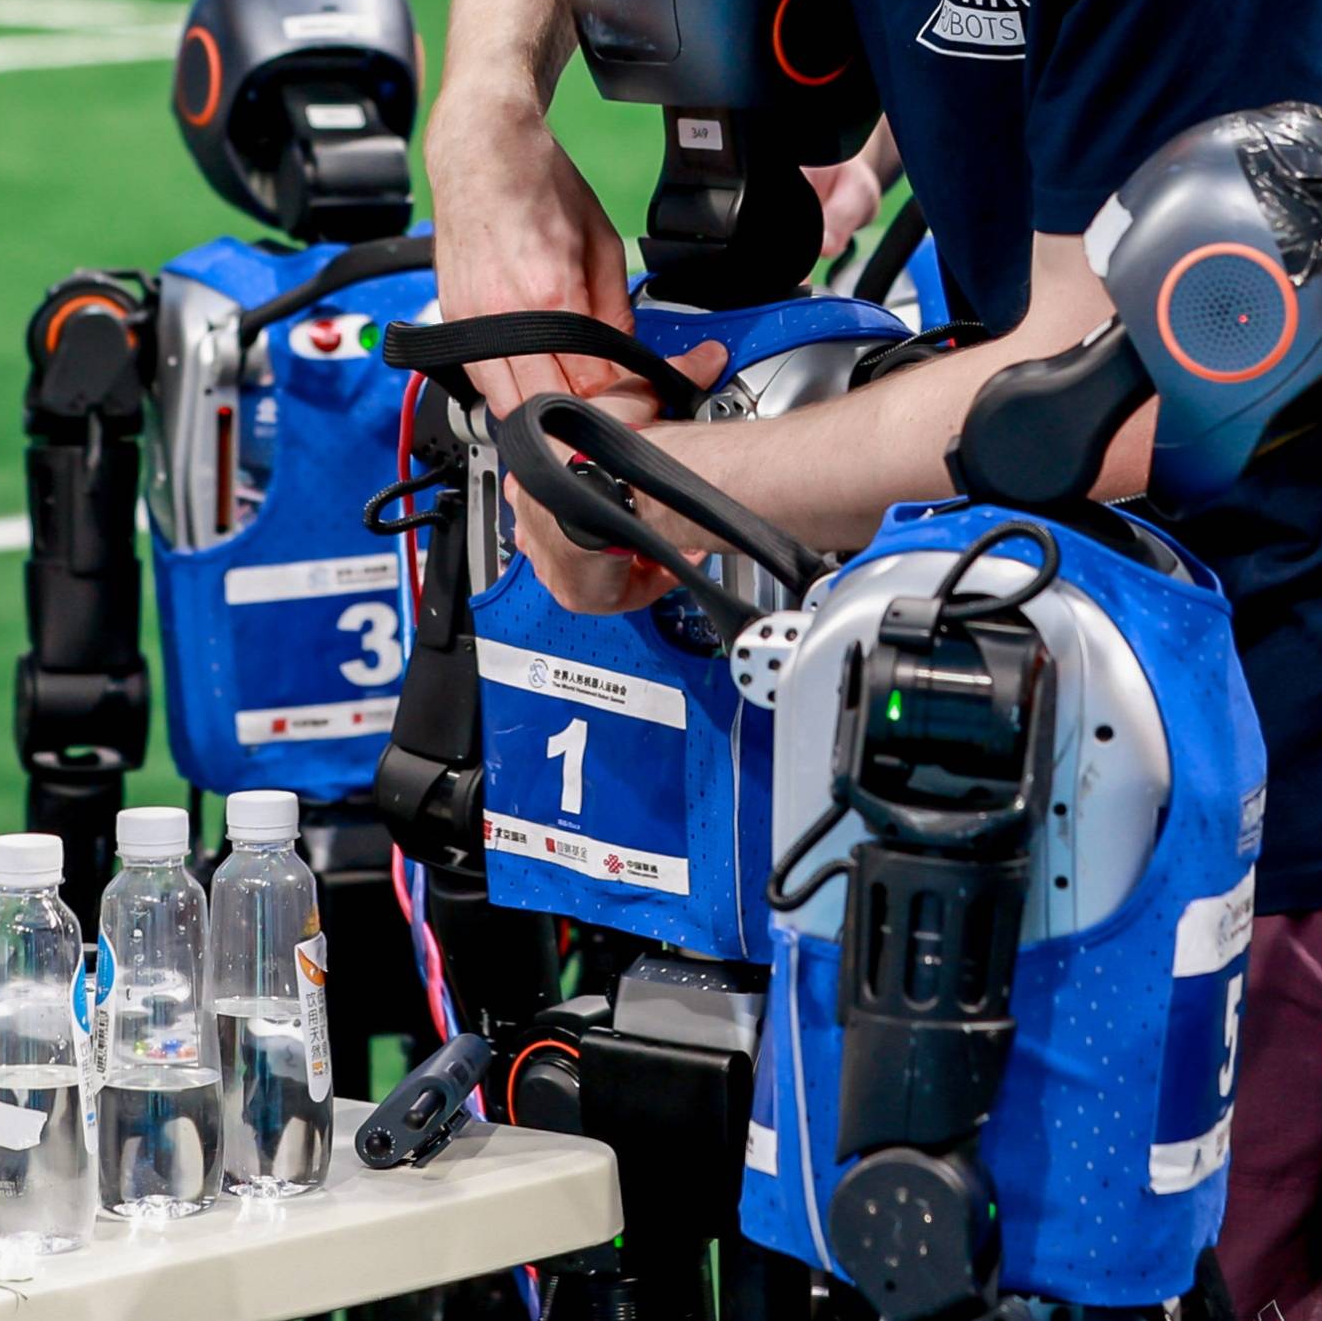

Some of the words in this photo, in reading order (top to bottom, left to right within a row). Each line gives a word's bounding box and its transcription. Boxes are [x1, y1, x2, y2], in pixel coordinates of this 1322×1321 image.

[336, 601, 403, 686] 3
[547, 718, 588, 815] 1
[1218, 972, 1244, 1098] 5
